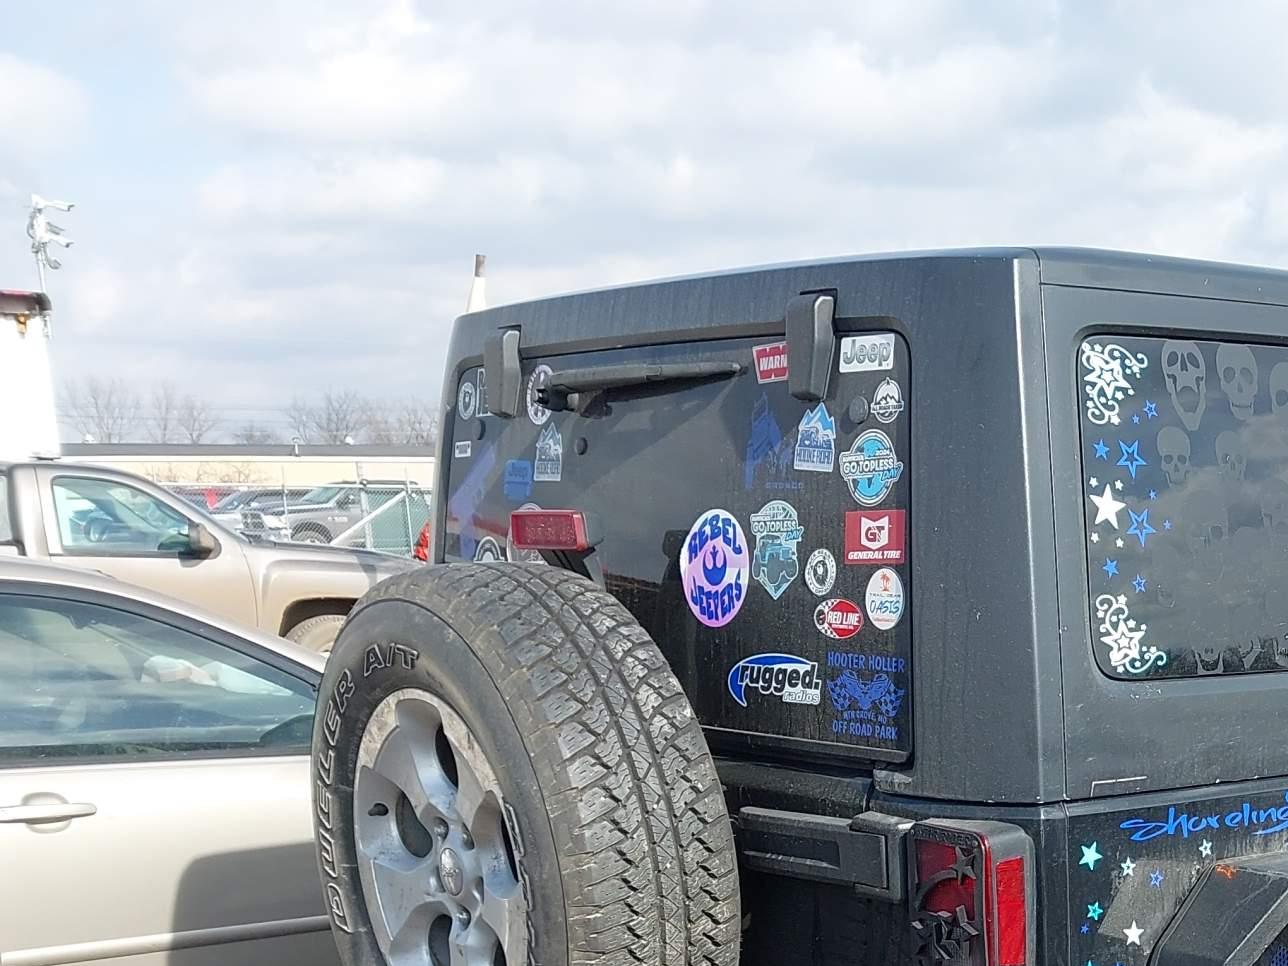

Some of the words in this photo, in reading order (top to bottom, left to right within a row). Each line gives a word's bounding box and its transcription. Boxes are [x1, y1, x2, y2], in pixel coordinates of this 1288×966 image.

[842, 339, 892, 367] Jeep
[760, 354, 788, 371] WARN
[843, 462, 858, 474] GO
[860, 458, 894, 473] TOPLESS
[881, 469, 899, 481] DAY
[752, 521, 765, 532] GO
[766, 520, 796, 532] TOPLESS
[865, 526, 885, 542] GT
[688, 513, 742, 565] REBEL
[785, 529, 800, 541] DAY
[848, 550, 882, 560] GENERAL
[883, 550, 901, 559] TIRE
[691, 567, 742, 621] JEEPERS
[870, 599, 900, 614] OASIS
[828, 611, 842, 624] RED
[842, 612, 860, 626] LINE
[364, 643, 418, 676] A/T
[827, 651, 866, 669] HOOTER
[868, 655, 905, 672] HOLLER
[783, 690, 819, 702] radios
[832, 719, 848, 733] OFF
[849, 722, 873, 736] ROAD
[875, 725, 898, 739] PARK
[317, 668, 355, 933] DUELER
